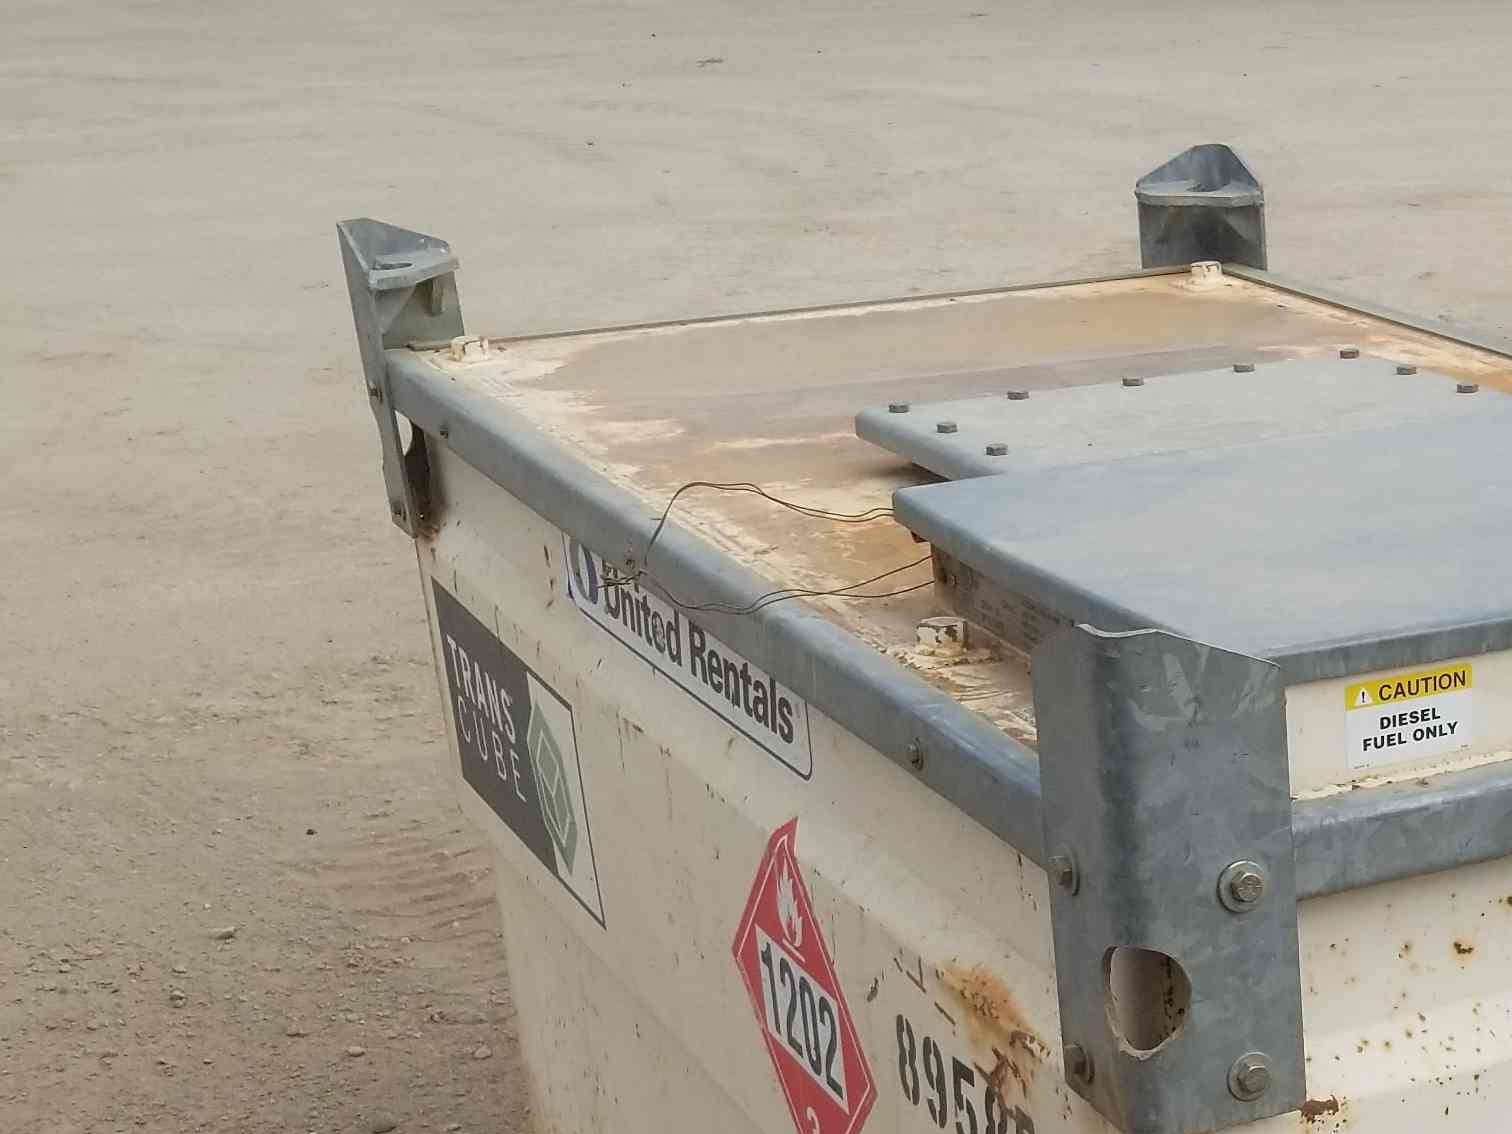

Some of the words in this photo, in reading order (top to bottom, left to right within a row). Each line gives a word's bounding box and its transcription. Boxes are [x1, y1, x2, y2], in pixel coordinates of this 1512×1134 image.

[447, 634, 516, 744] TRANS
[602, 560, 682, 667] United
[688, 618, 794, 744] Rentals
[1378, 670, 1466, 702] CAUTION
[458, 695, 527, 802] CUBE
[1362, 732, 1407, 752] FUEL
[1413, 721, 1458, 742] ONLY
[1379, 707, 1441, 730] DIESEL
[761, 941, 844, 1100] 1202
